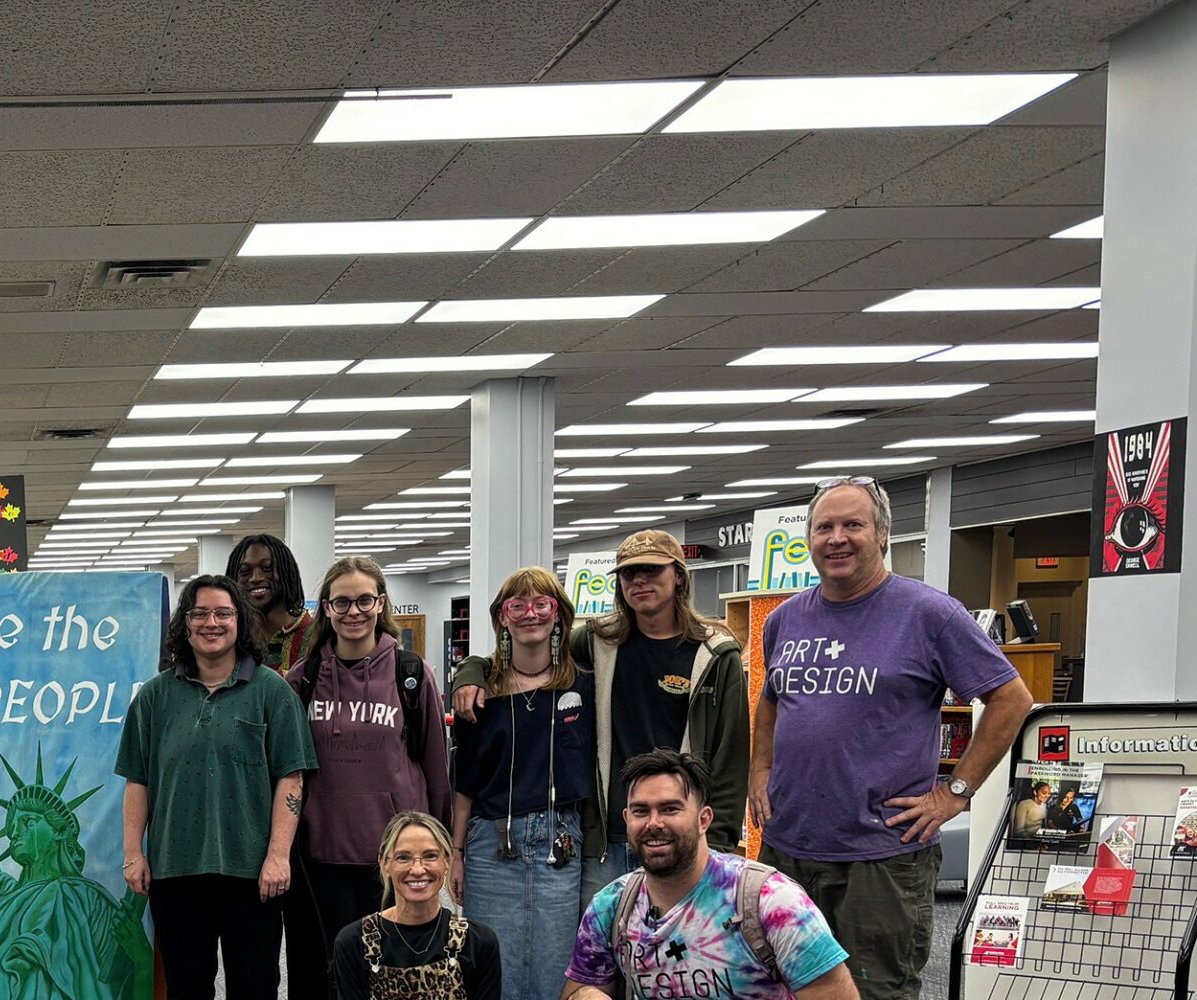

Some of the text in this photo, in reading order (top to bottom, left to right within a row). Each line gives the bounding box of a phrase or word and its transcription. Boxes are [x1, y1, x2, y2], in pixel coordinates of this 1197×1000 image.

[1124, 431, 1153, 463] 1984
[42, 604, 120, 652] the
[770, 666, 879, 696] DESIGN
[307, 700, 399, 728] NEW YORK
